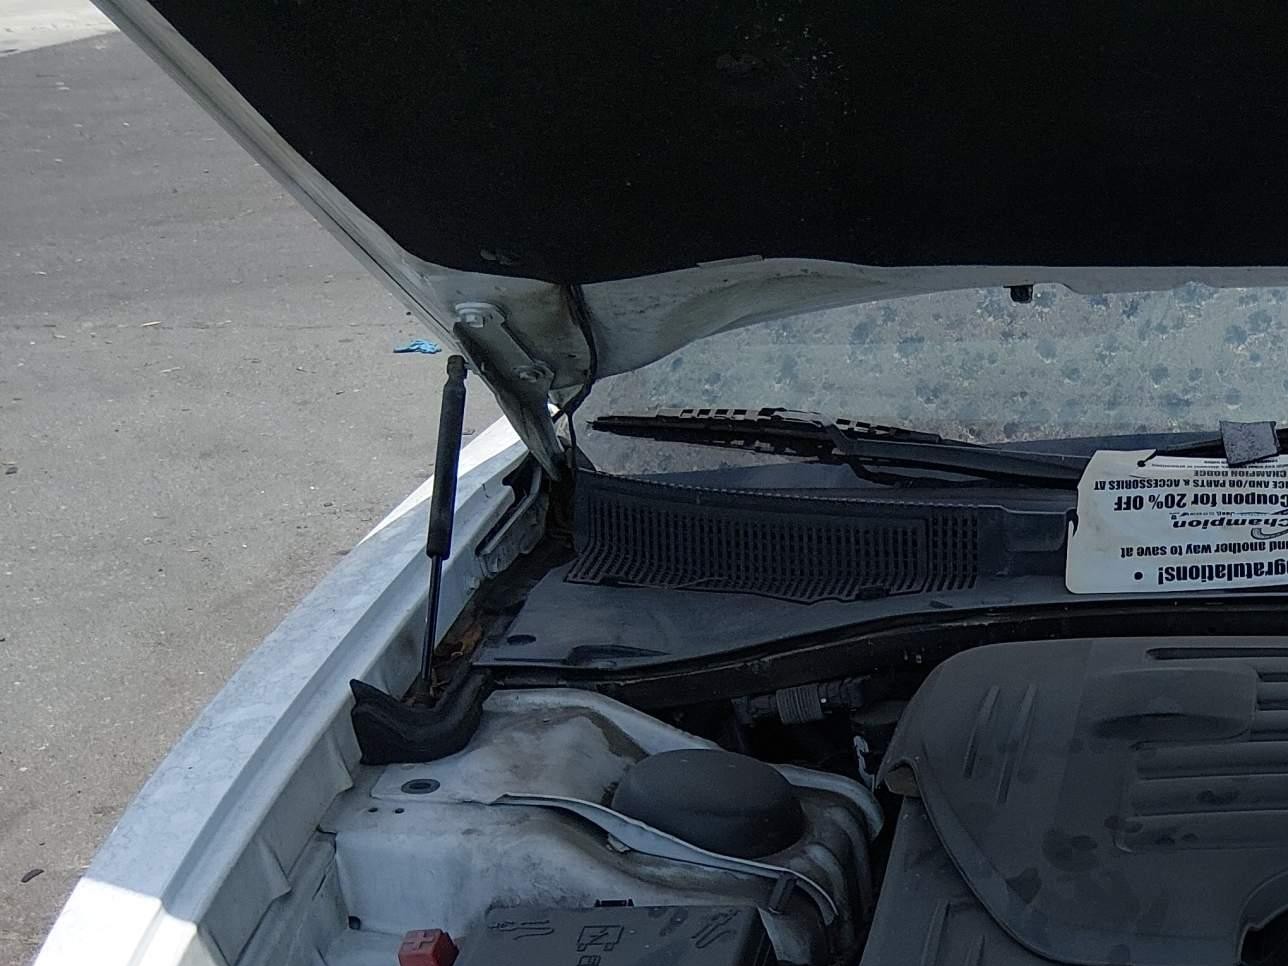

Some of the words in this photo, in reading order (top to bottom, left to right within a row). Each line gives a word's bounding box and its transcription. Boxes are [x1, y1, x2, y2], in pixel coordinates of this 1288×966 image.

[1231, 470, 1287, 478] CHAMPION
[1094, 480, 1106, 491] AT
[1108, 479, 1180, 490] ACCESSORIES
[1193, 479, 1226, 488] PARTS
[1114, 495, 1144, 511] OFF
[1148, 493, 1187, 510] 20%
[1191, 493, 1217, 508] for
[1120, 547, 1133, 558] at
[1137, 545, 1167, 557] save
[1170, 545, 1183, 556] to
[1185, 543, 1212, 555] way
[1214, 541, 1266, 554] another
